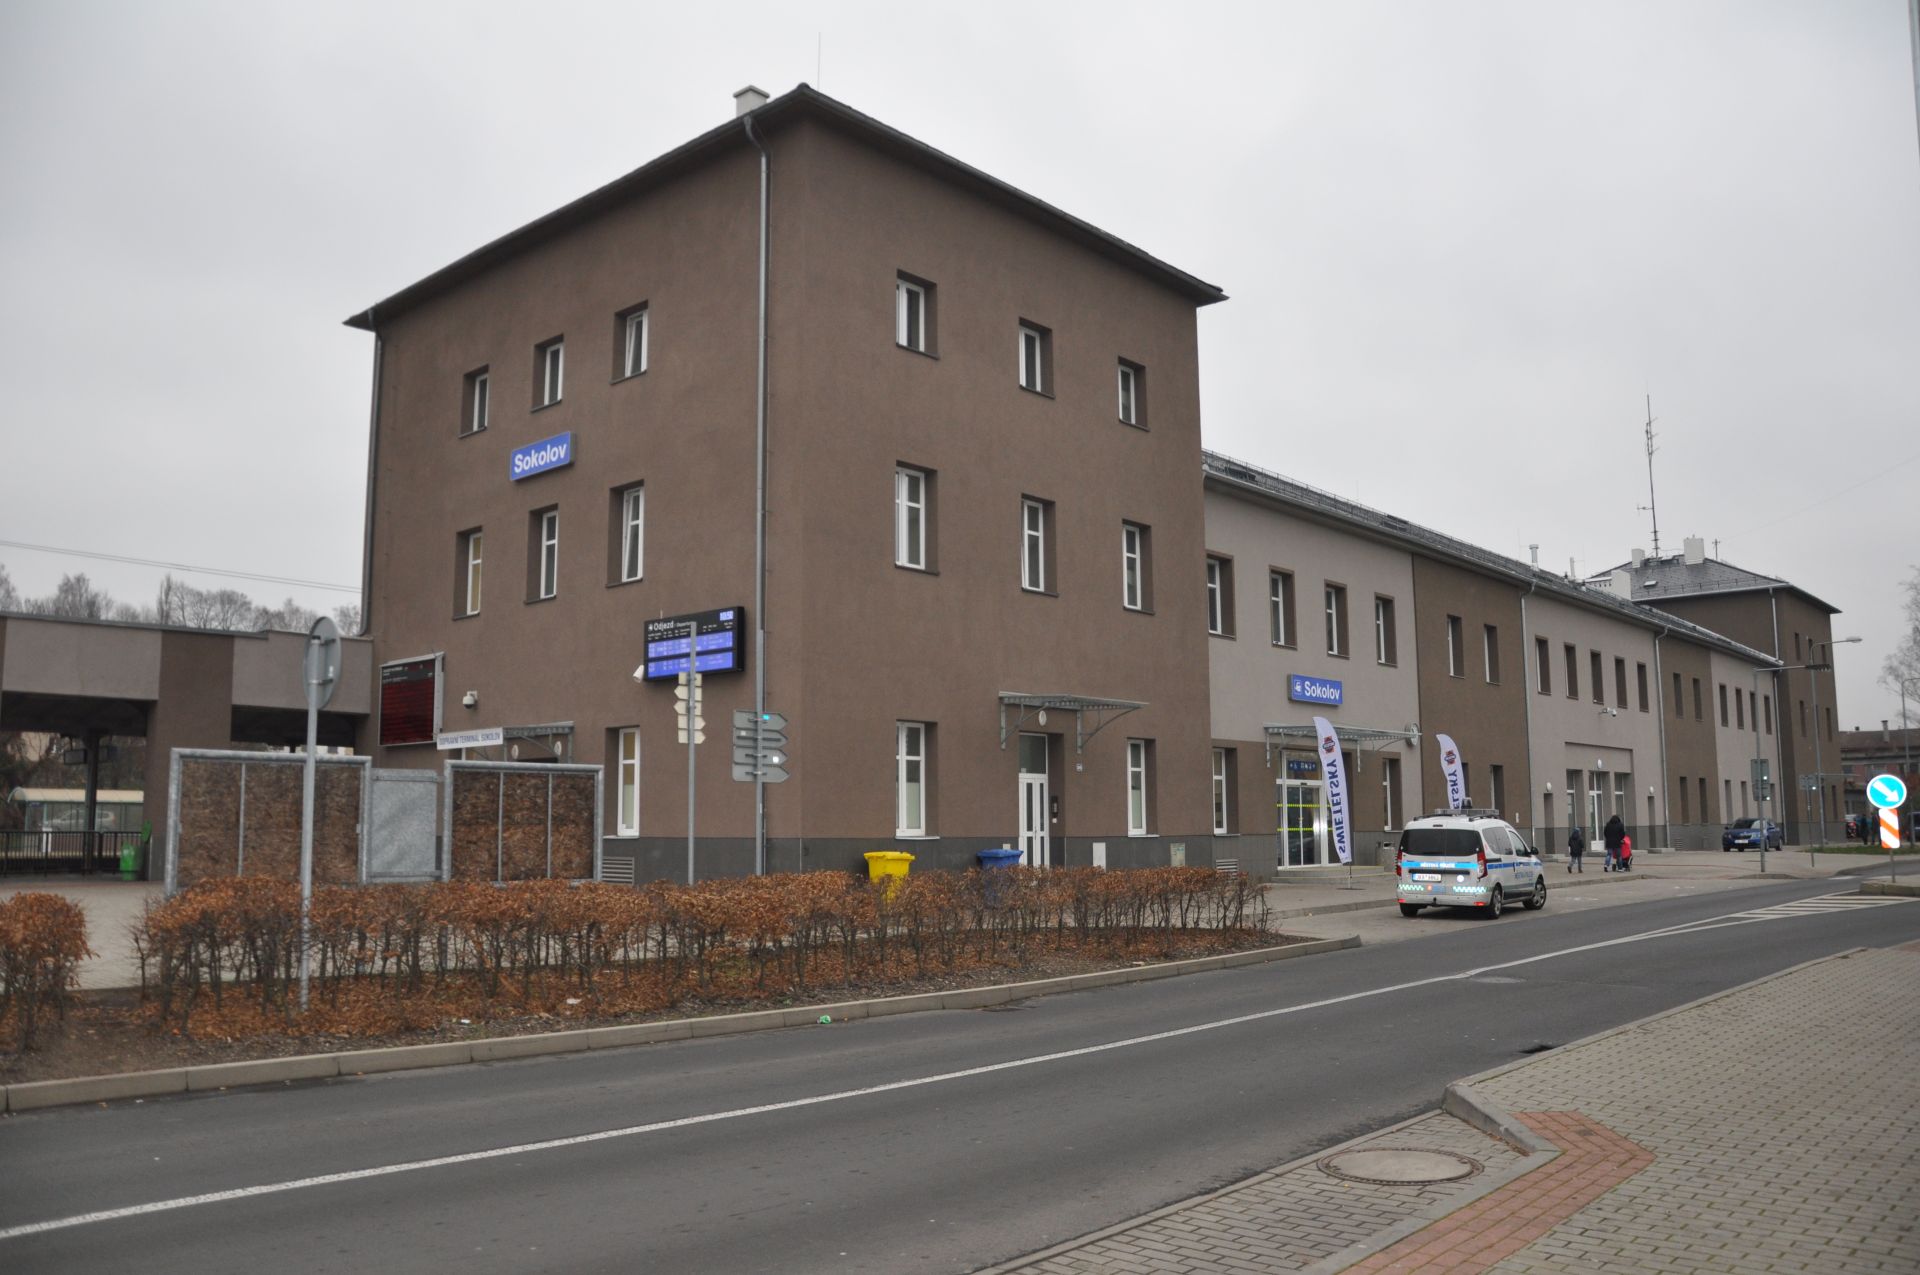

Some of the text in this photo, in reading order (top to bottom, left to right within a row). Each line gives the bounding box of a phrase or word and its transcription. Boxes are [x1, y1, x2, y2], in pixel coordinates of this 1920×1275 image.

[514, 444, 567, 474] Sokolov
[653, 620, 674, 631] Odjezd
[1304, 681, 1340, 700] Sokolov
